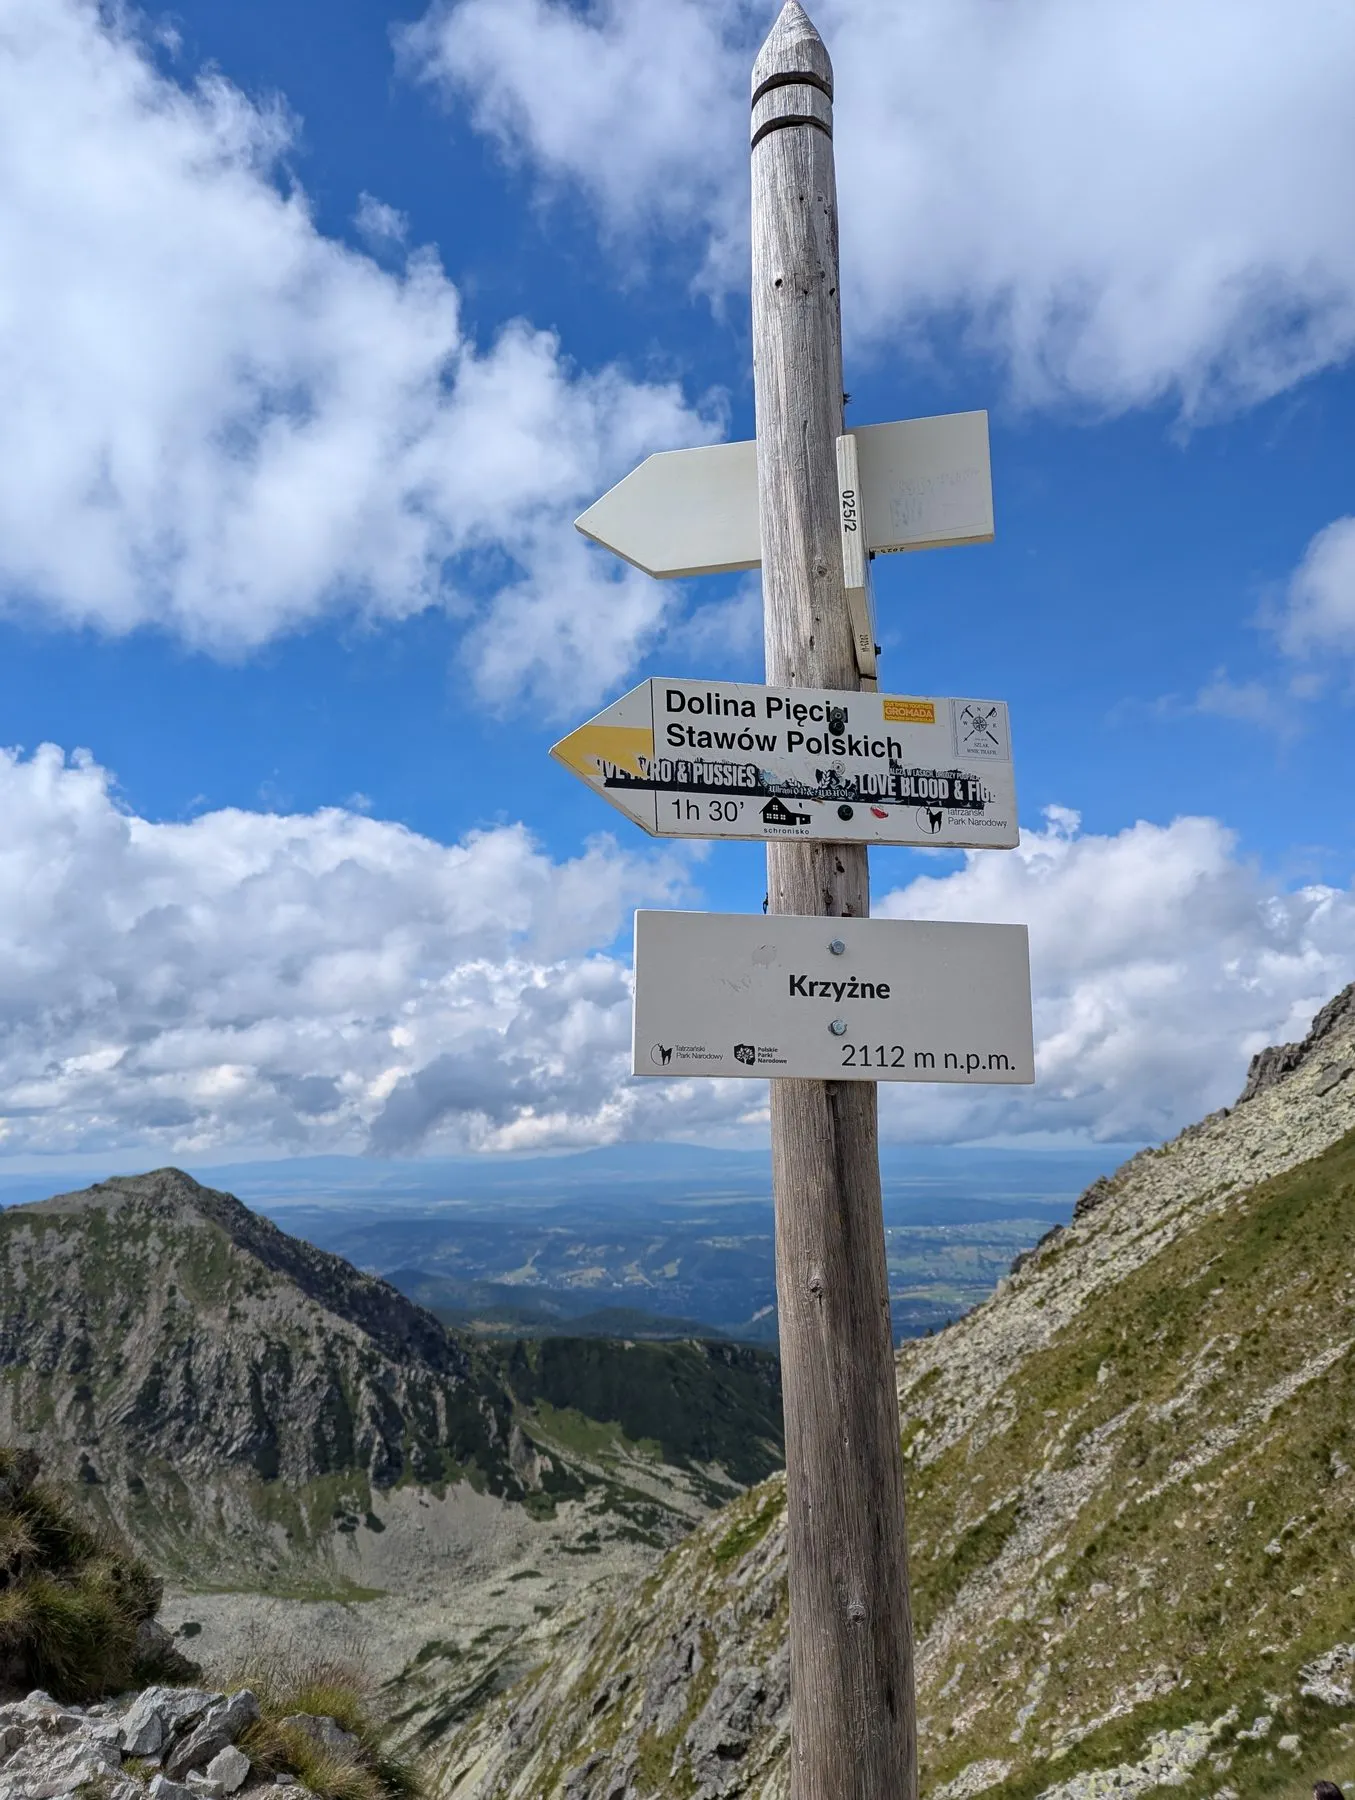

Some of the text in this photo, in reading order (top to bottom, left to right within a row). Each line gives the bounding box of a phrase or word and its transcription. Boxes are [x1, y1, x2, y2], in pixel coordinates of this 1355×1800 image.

[843, 490, 857, 532] 025/2
[666, 690, 848, 727] Dolina Pięciu
[885, 706, 934, 719] GROMADA
[666, 723, 902, 759] Stawów Polskich
[677, 762, 688, 783] &
[693, 762, 756, 788] PUSSIES
[858, 774, 897, 796] LOVE
[901, 777, 949, 800] BLOOD
[953, 781, 964, 800] &
[672, 799, 700, 820] 1h
[948, 816, 1008, 829] Park Narodowy
[763, 827, 810, 835] schronisko
[789, 974, 891, 1002] Krzyżne
[692, 1053, 724, 1062] Narodowy
[841, 1044, 1016, 1074] 2112 m n.p.m.
